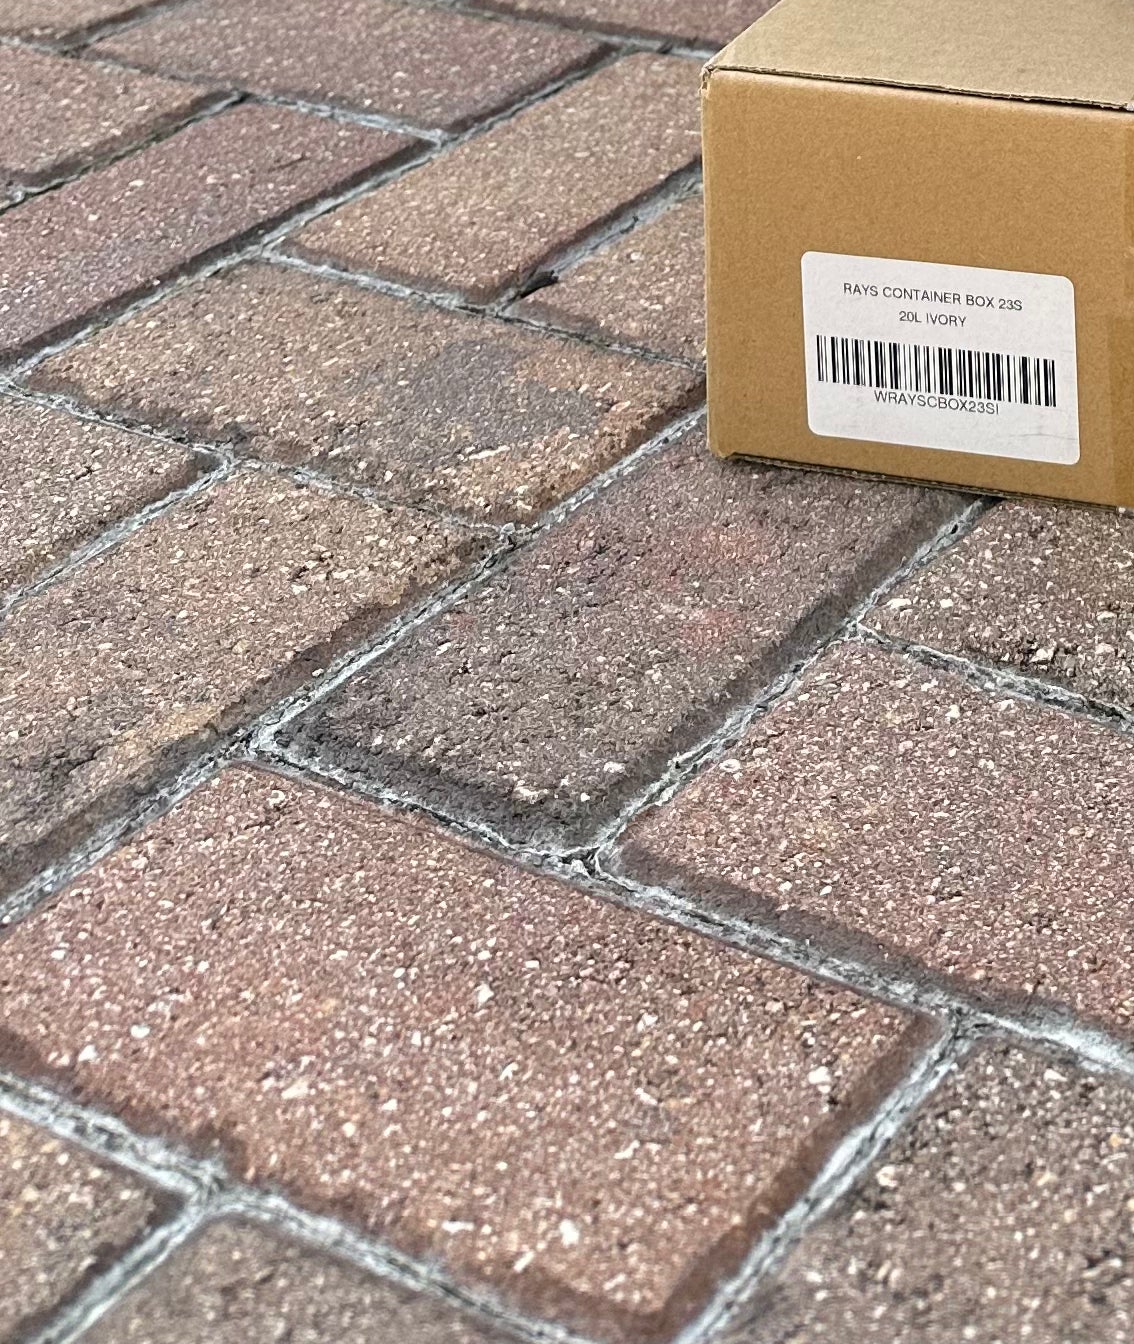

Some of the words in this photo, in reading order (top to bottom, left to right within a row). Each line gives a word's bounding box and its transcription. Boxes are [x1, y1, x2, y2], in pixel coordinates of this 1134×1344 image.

[843, 282, 879, 299] RAYS
[882, 286, 962, 305] CONTAINER
[965, 294, 995, 309] BOX
[998, 298, 1023, 311] 23S
[898, 310, 923, 324] 20L
[926, 313, 967, 327] IVORY
[874, 390, 1000, 415] WRAYSCBOX23SI
